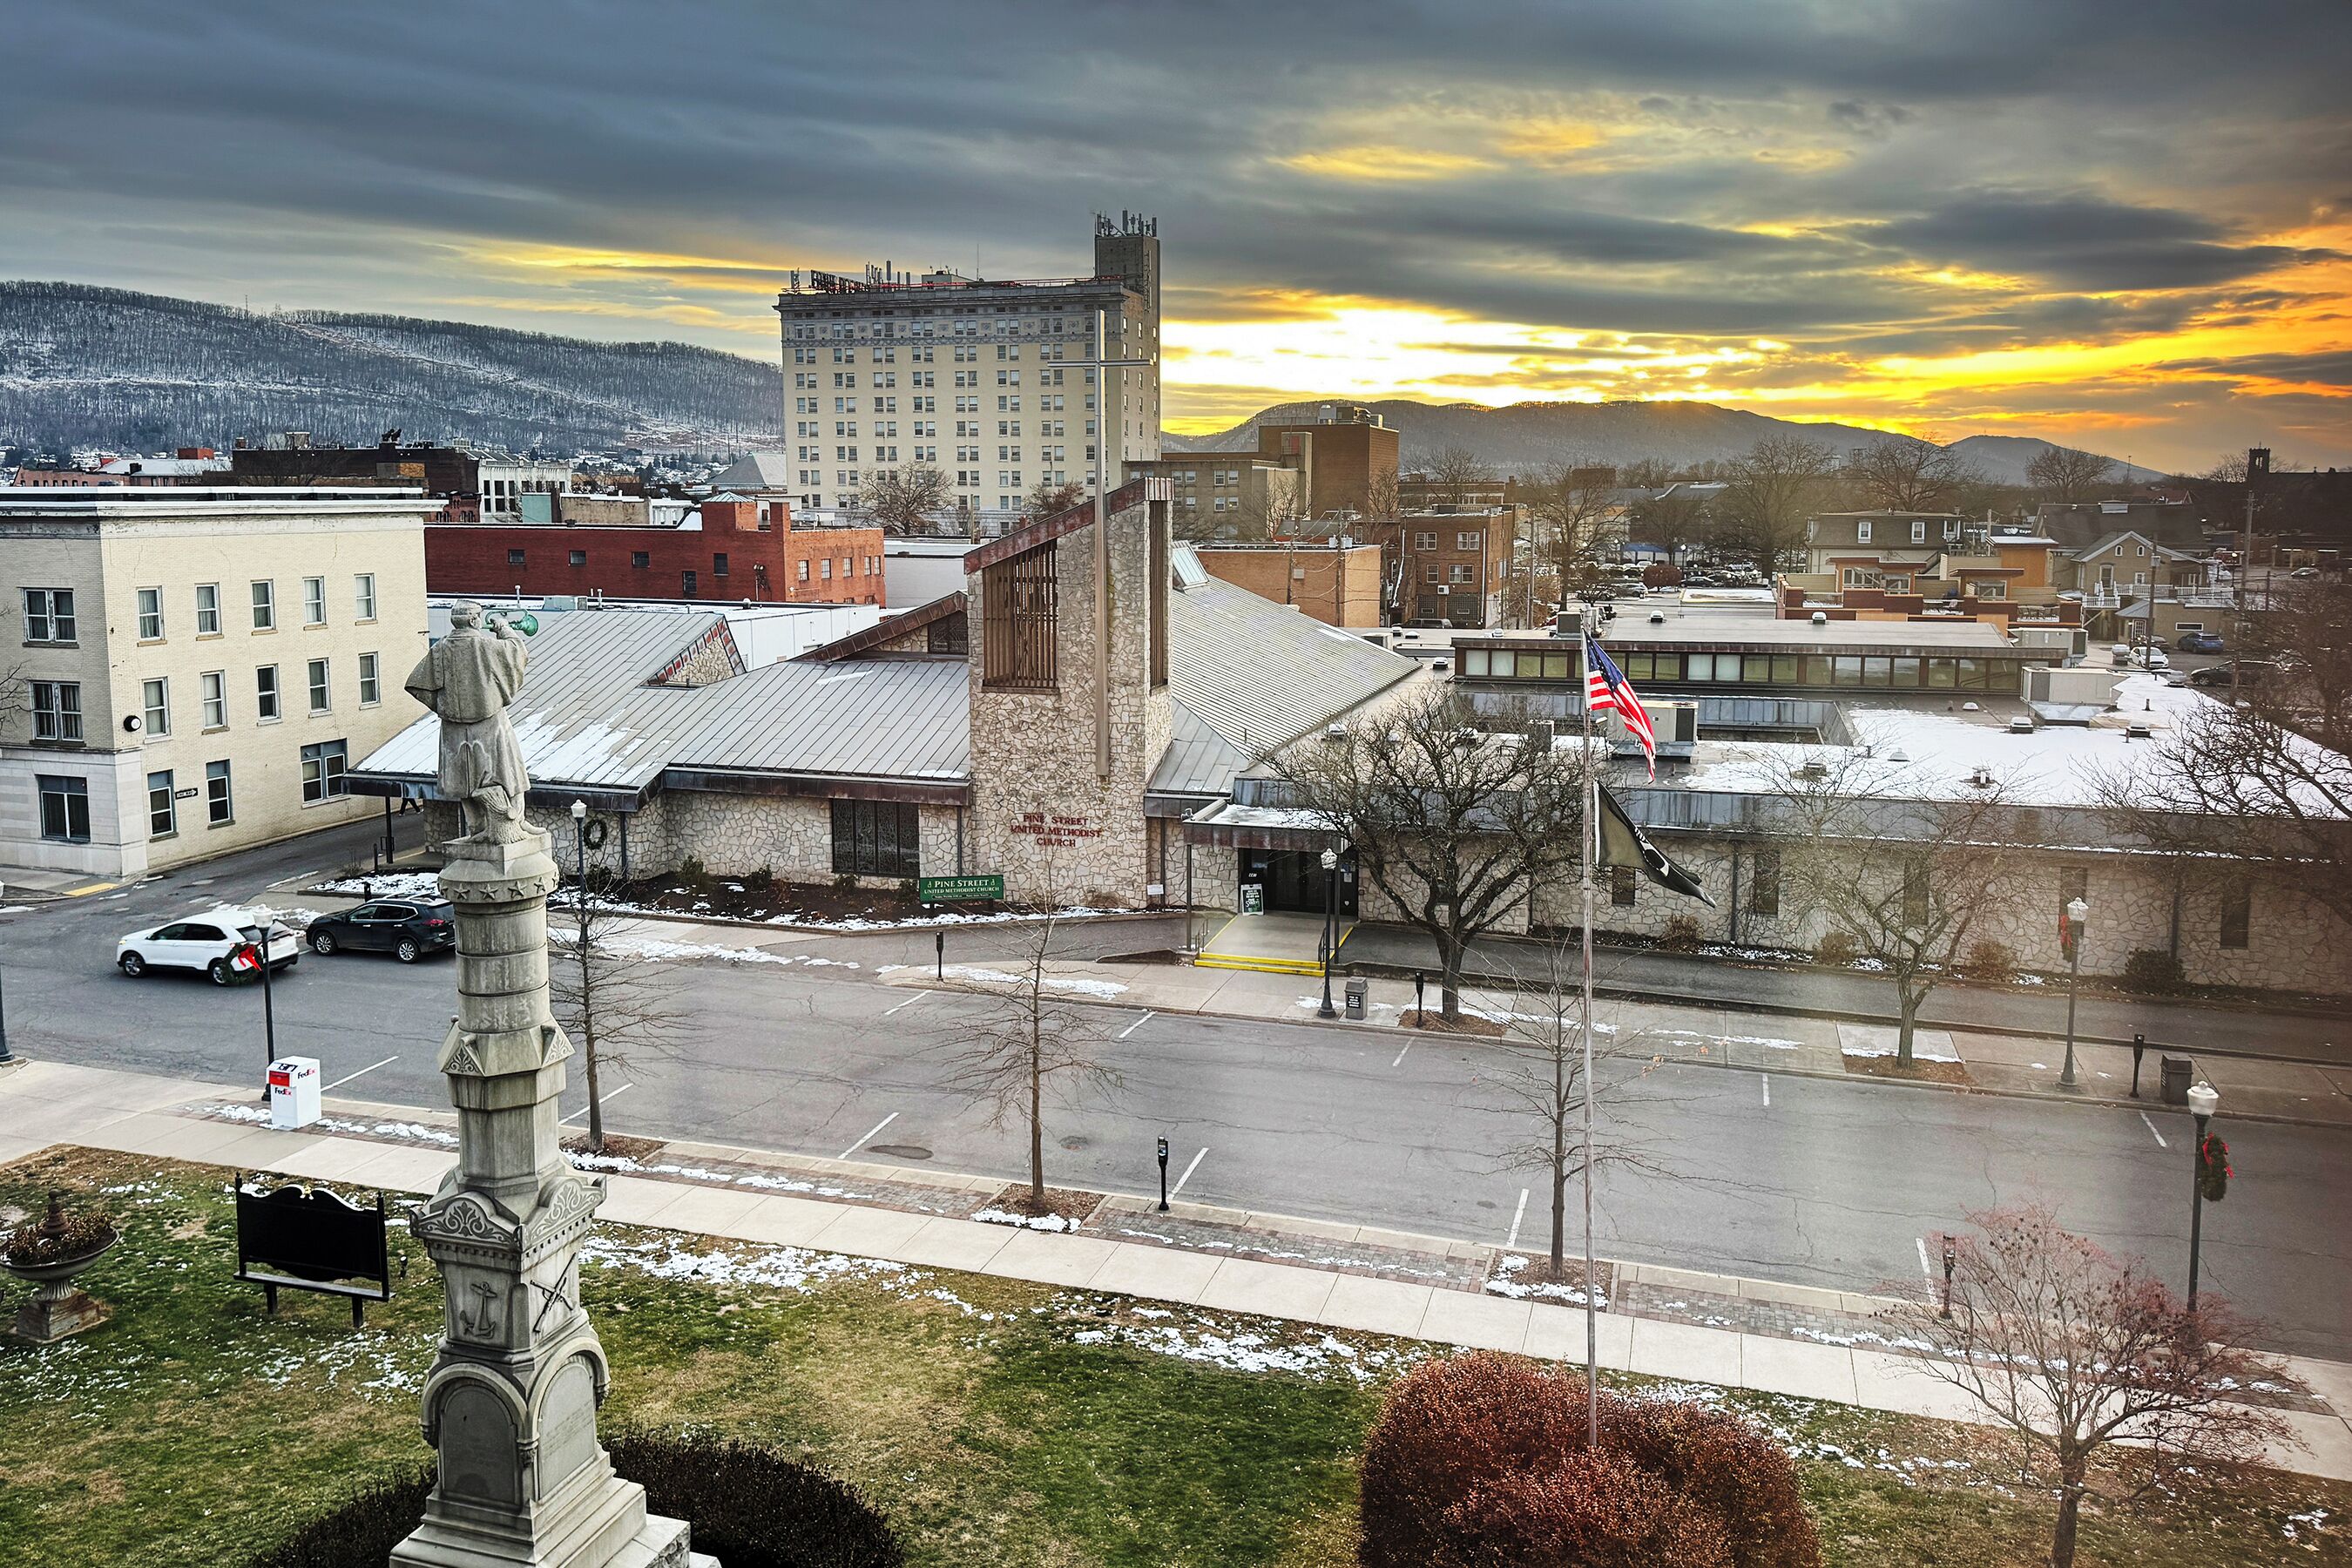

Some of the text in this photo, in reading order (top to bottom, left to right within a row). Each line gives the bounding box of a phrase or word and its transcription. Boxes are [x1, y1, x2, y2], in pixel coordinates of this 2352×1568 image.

[1023, 814, 1089, 826] PINE STREET
[1010, 825, 1102, 838] UNITED METHODIST
[1037, 838, 1076, 848] CHURCH
[297, 1068, 315, 1079] FedEx
[274, 1087, 293, 1096] FedEx
